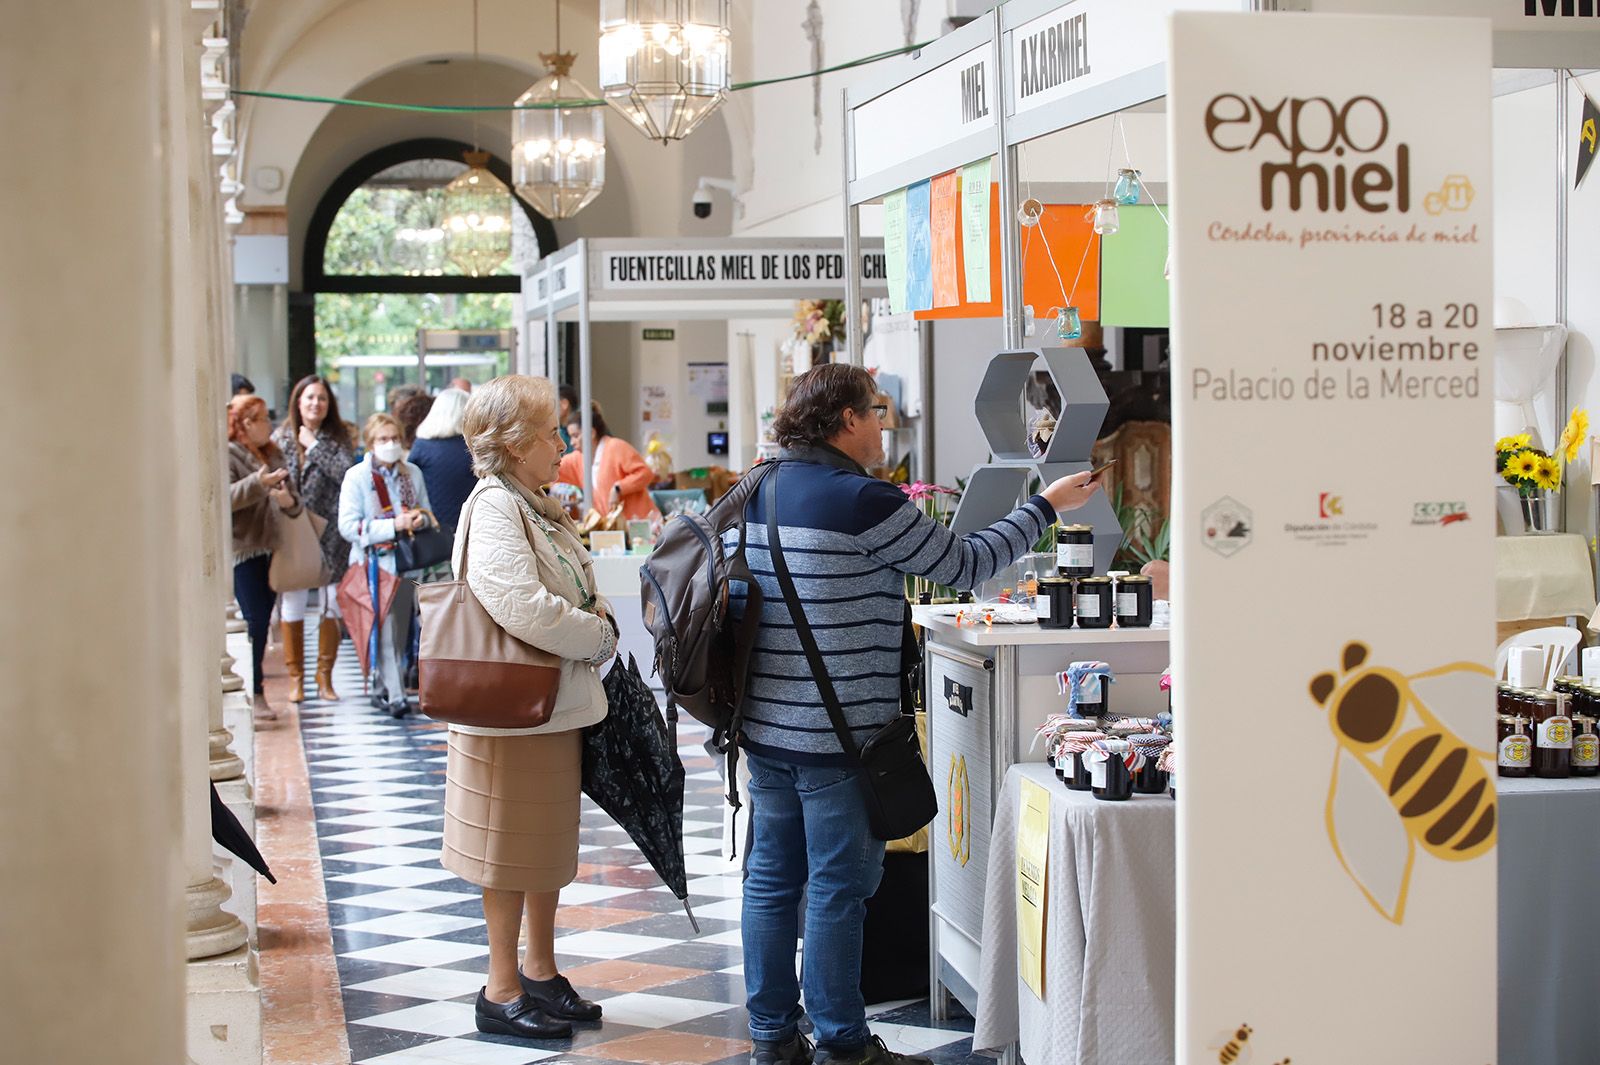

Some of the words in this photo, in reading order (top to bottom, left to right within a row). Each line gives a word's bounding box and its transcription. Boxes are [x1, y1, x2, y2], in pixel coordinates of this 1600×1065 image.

[1020, 12, 1091, 98] AXARMIEL
[960, 61, 989, 125] MIEL
[1204, 93, 1389, 163] expo
[1260, 143, 1410, 213] miel
[1299, 224, 1400, 249] provincia
[1405, 223, 1426, 243] de
[1432, 224, 1480, 244] miel
[610, 255, 716, 281] FUENTECILLAS
[721, 255, 756, 280] MIEL
[762, 254, 779, 280] DE
[784, 254, 811, 280] LOS
[1371, 303, 1406, 328] 18
[1416, 309, 1432, 328] a
[1444, 303, 1479, 328] 20
[1312, 336, 1480, 361] noviembre
[1193, 367, 1295, 400] Palacio
[1304, 367, 1336, 400] de
[1346, 367, 1369, 400] la
[1380, 367, 1480, 399] Merced
